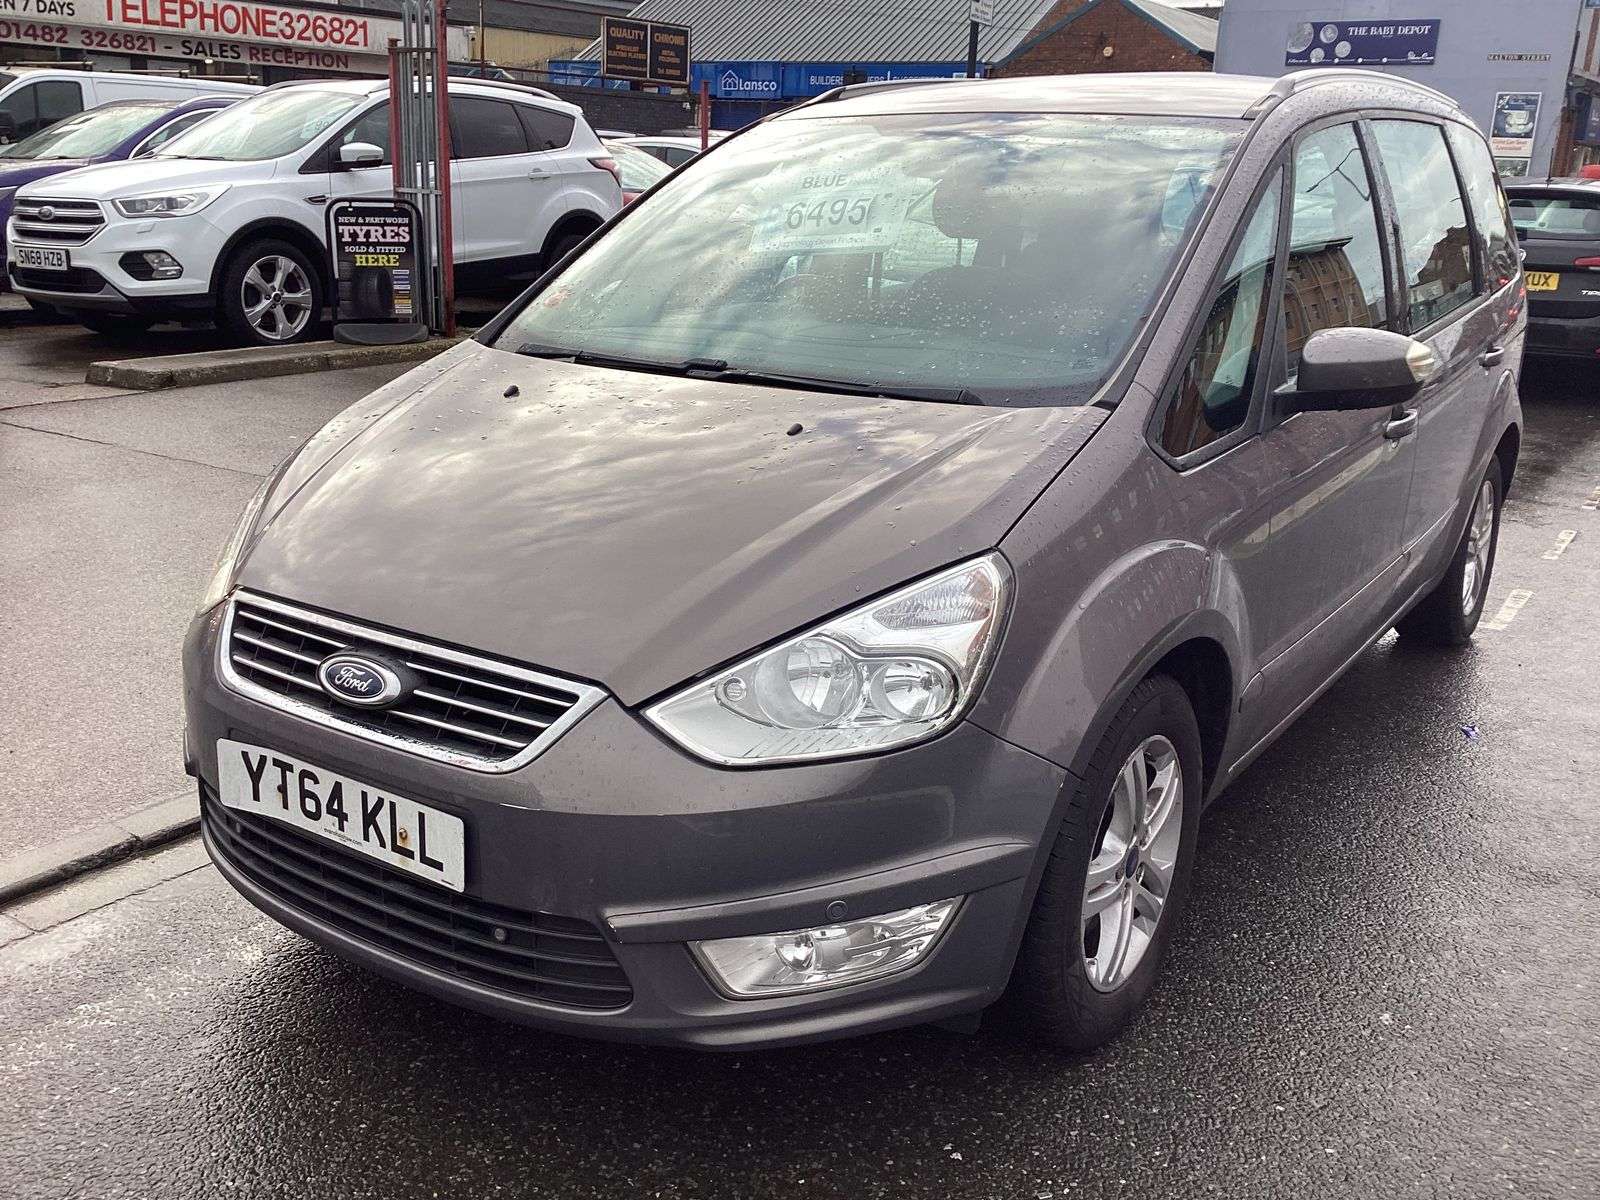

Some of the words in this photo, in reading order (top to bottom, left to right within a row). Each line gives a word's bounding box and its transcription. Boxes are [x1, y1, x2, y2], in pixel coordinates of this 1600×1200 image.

[36, 0, 75, 16] DAYS
[610, 27, 645, 40] QUALITY
[1347, 26, 1368, 36] THE
[1370, 26, 1395, 35] BABY
[1397, 25, 1432, 35] DEPOT
[0, 20, 69, 44] 01482
[80, 29, 156, 52] 326821
[181, 39, 241, 60] SALES
[250, 47, 349, 69] RECEPTION
[654, 33, 685, 46] CHROME
[740, 78, 777, 91] Lansco
[801, 173, 848, 189] BLUE
[785, 197, 872, 230] 6495
[338, 225, 410, 243] TYRES
[19, 249, 42, 265] SN68
[43, 251, 63, 267] HZB
[354, 254, 400, 267] HERE
[334, 666, 371, 693] Ford
[241, 750, 348, 832] YT64
[361, 790, 444, 872] KLL
